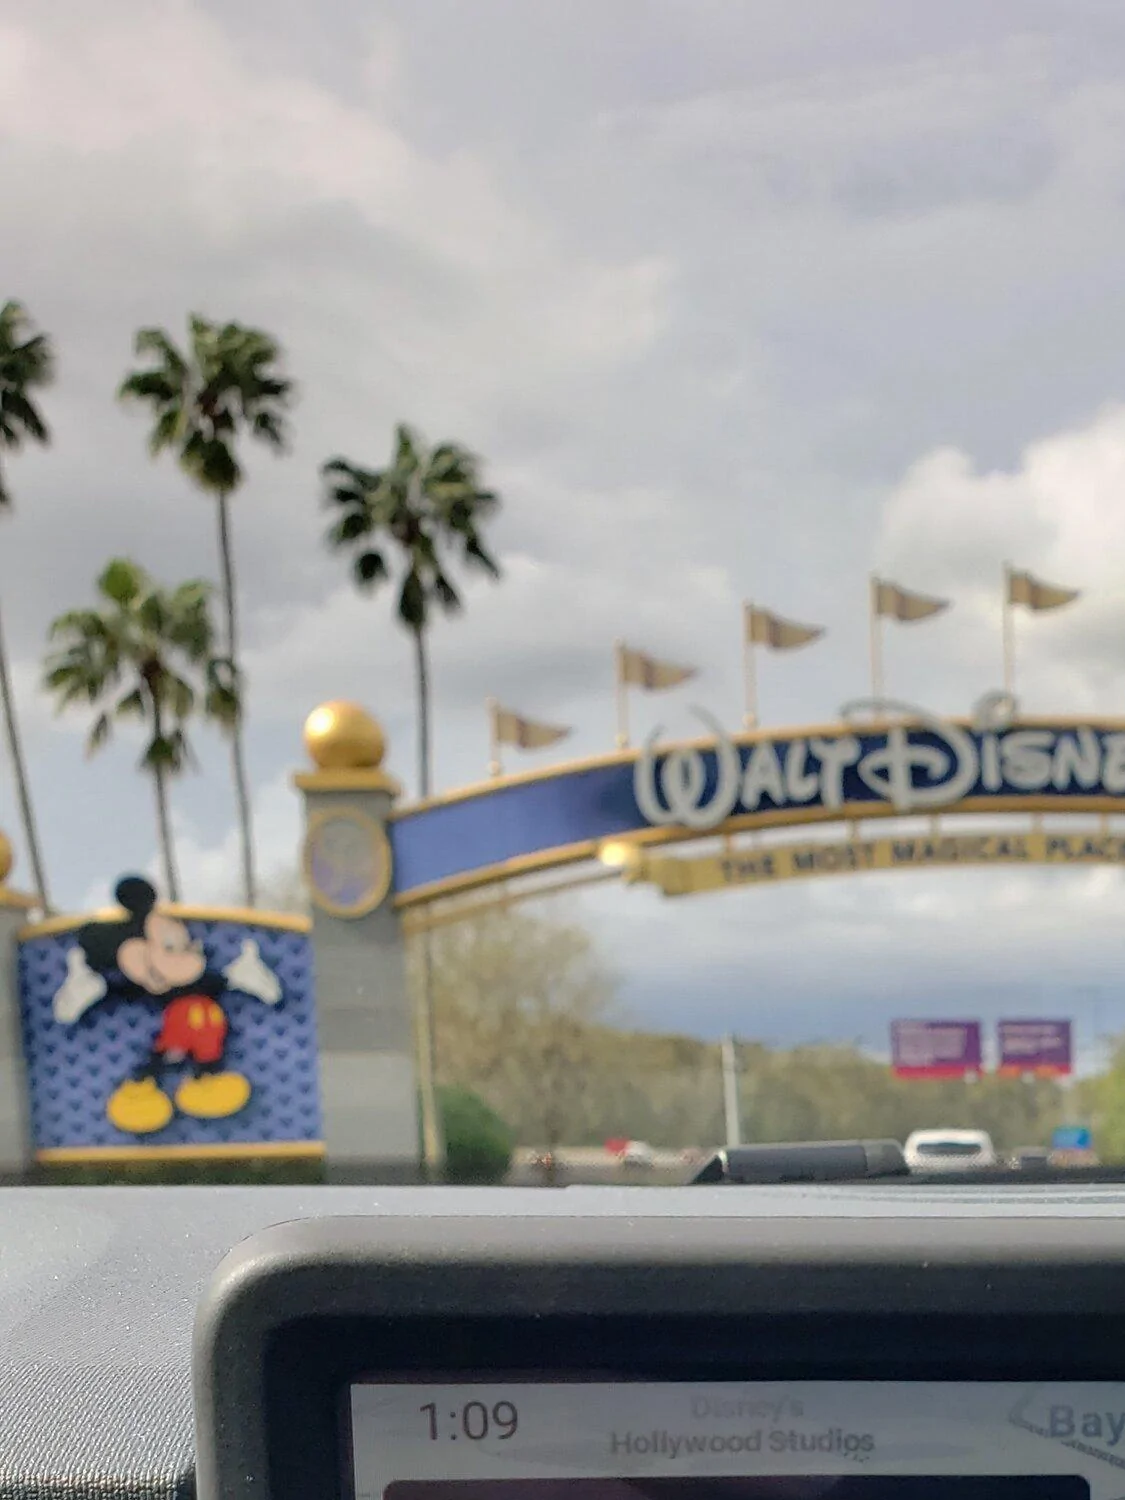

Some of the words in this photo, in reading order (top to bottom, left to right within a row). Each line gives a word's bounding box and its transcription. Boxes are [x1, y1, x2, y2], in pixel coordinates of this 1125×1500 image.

[720, 852, 775, 882] THE
[792, 841, 876, 873] MOST
[892, 834, 1026, 863] MAGICAL
[419, 1399, 519, 1442] 1:09
[611, 1428, 763, 1460] Hollywood
[768, 1427, 876, 1454] Studios
